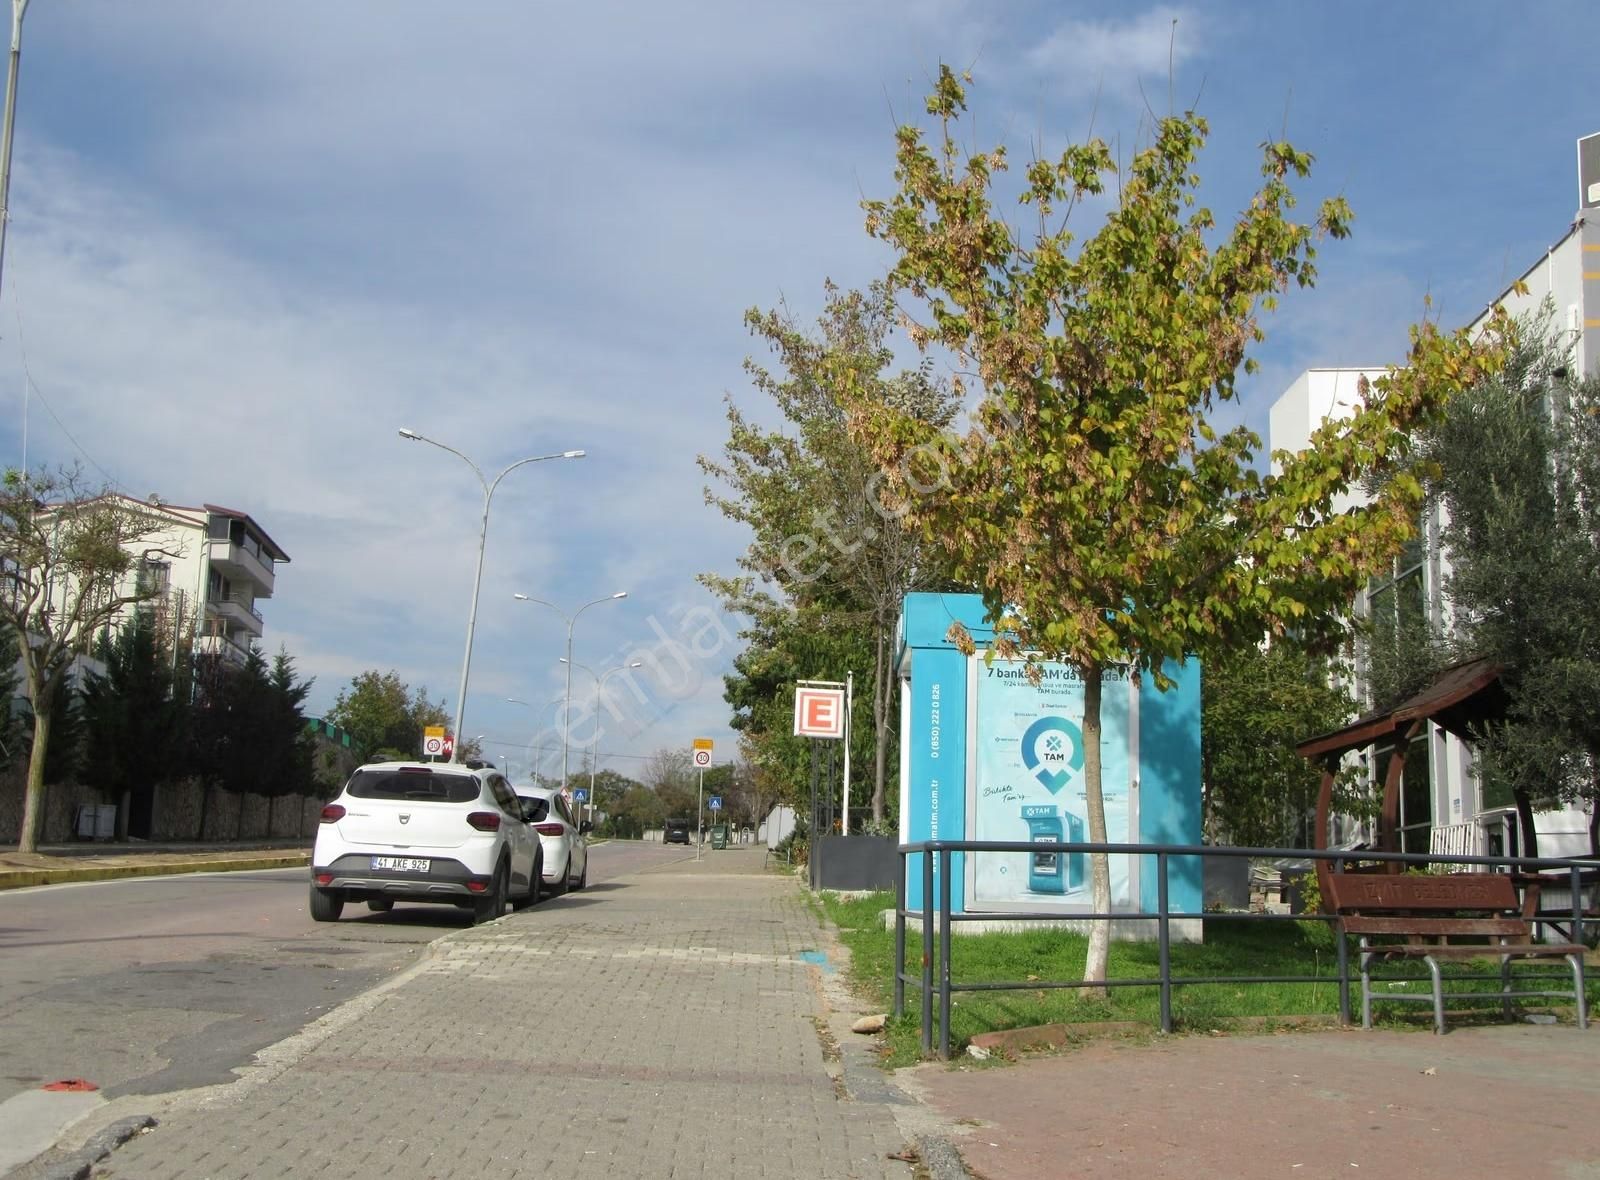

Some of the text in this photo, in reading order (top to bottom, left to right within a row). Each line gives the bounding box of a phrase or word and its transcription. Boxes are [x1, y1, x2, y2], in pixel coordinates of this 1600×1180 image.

[988, 668, 994, 678] 7
[931, 684, 940, 700] 826
[807, 699, 832, 728] E
[931, 709, 939, 725] 222
[931, 726, 940, 750] (850)
[1035, 807, 1050, 815] TAM
[377, 858, 428, 870] 41 AKE 925
